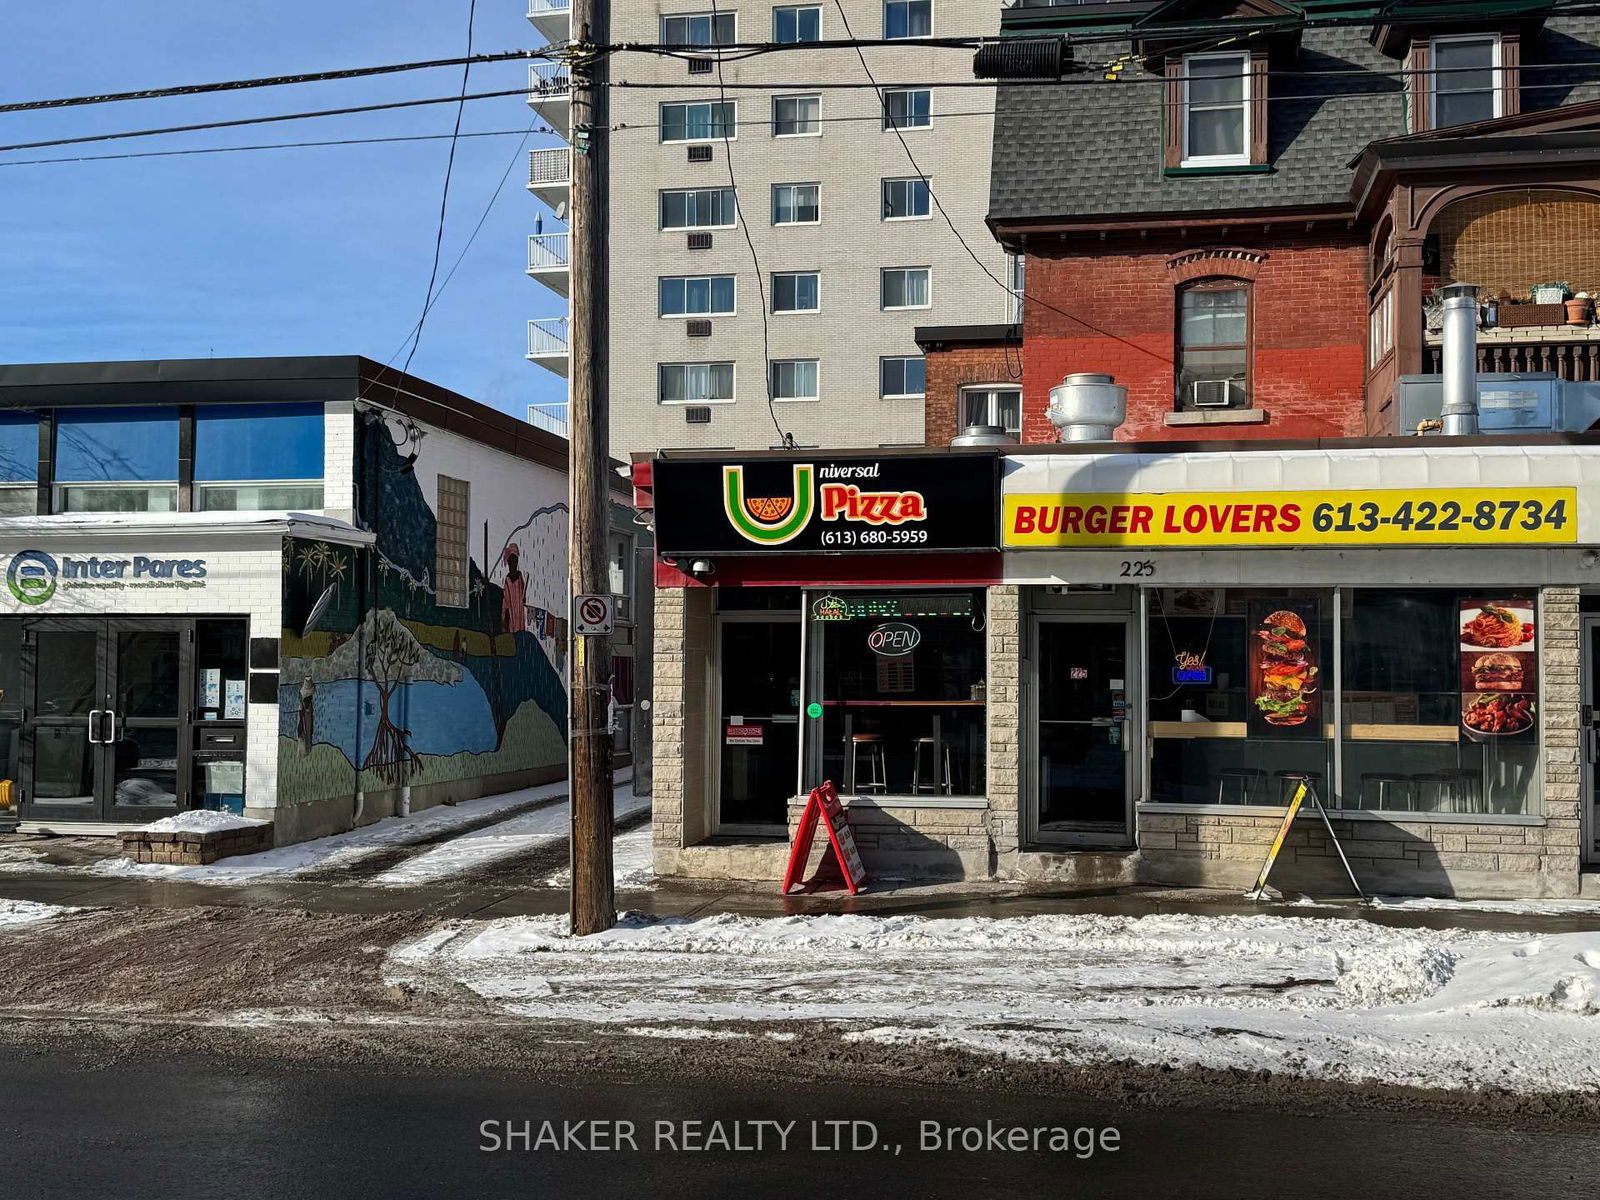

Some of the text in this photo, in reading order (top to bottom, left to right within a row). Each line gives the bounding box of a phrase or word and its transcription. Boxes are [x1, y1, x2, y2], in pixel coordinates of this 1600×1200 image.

[820, 483, 928, 525] Pizza
[1013, 499, 1568, 535] BURGER LOVERS 613-422-8734
[821, 530, 928, 545] (613) 680-5959
[62, 556, 207, 579] Inter Pares
[1120, 560, 1155, 577] 225
[871, 630, 916, 648] OPEN
